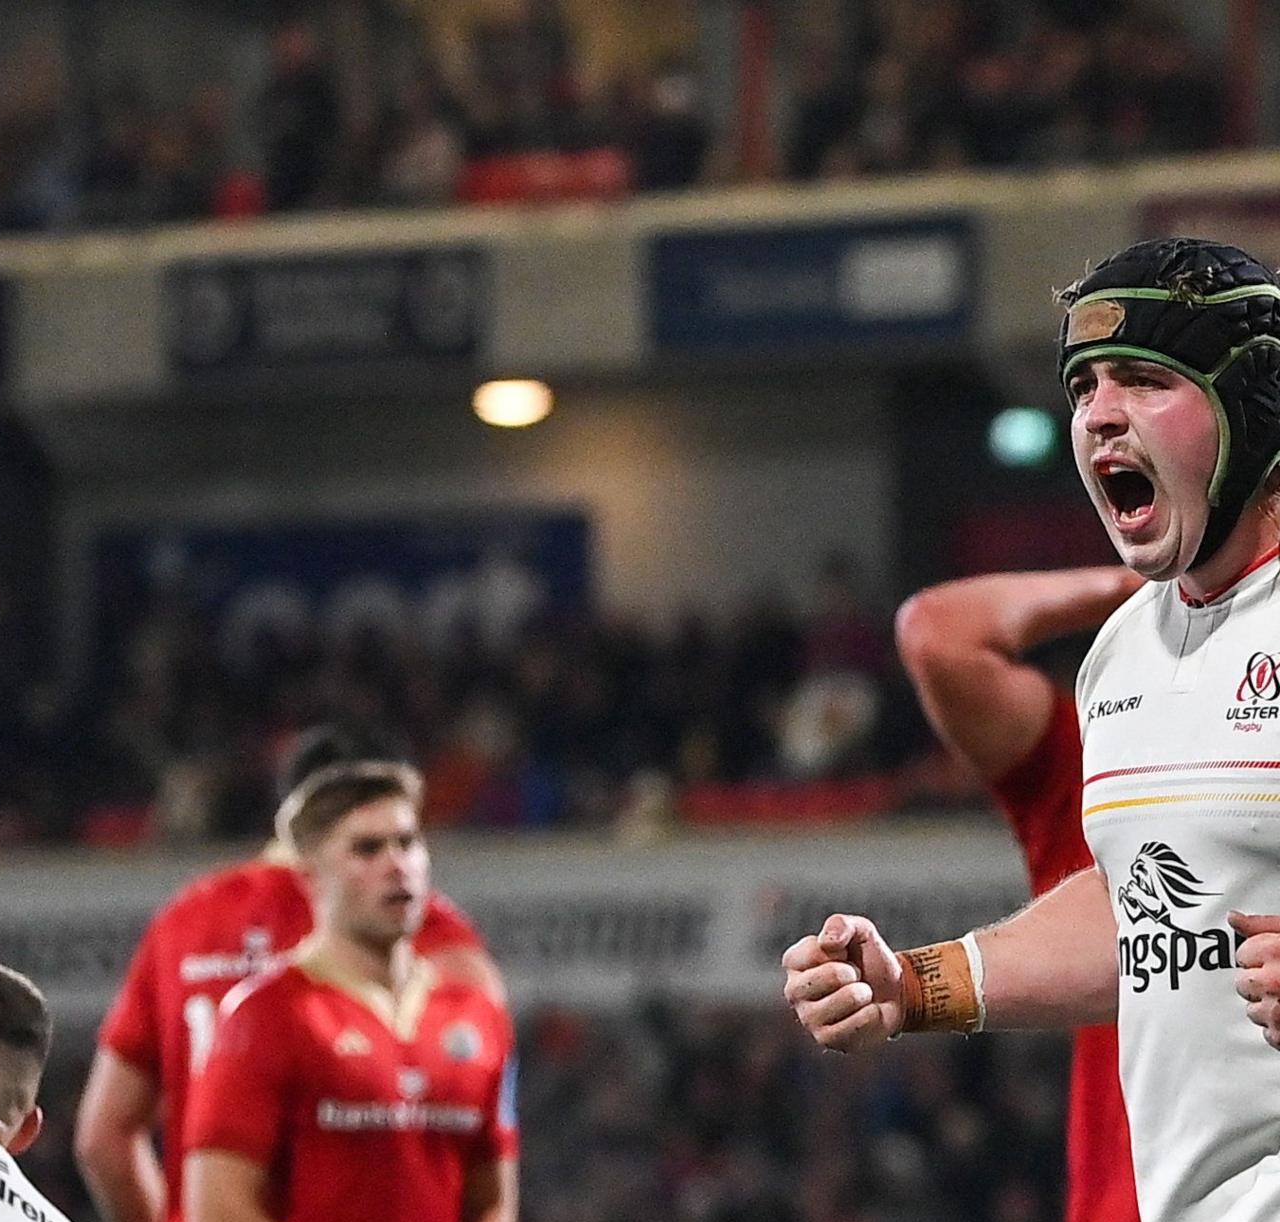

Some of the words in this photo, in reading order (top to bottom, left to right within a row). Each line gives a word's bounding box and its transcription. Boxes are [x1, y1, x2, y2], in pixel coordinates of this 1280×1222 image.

[1097, 695, 1143, 719] KUKRI
[1226, 706, 1279, 720] ULSTER
[1233, 722, 1263, 732] Rugby
